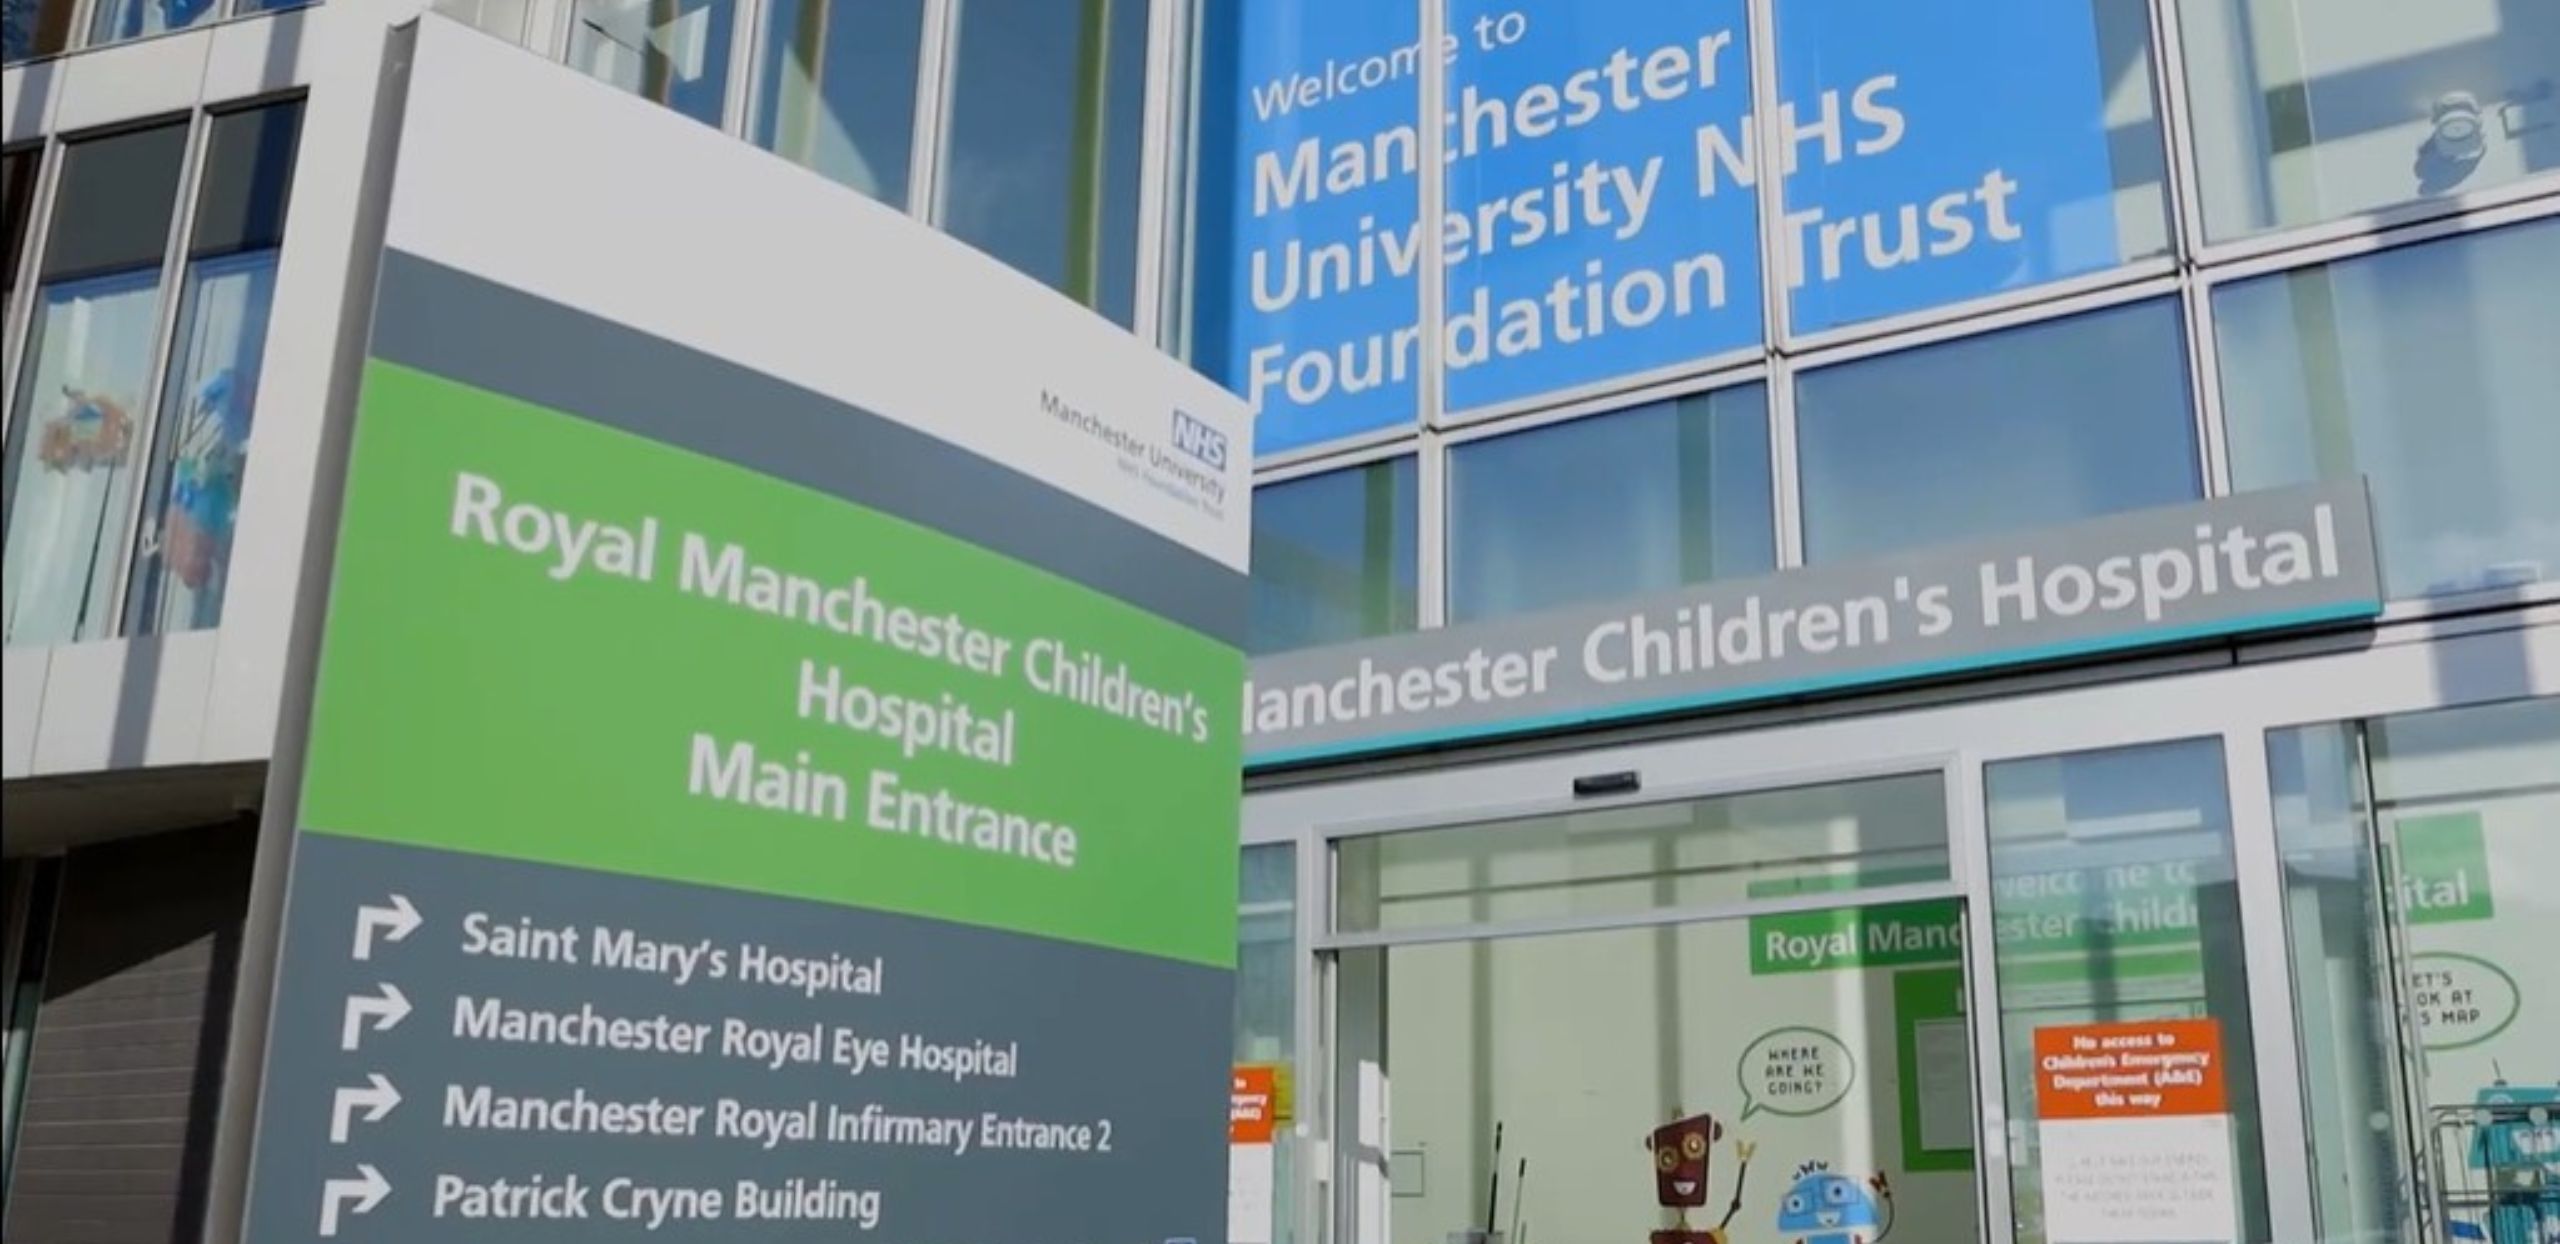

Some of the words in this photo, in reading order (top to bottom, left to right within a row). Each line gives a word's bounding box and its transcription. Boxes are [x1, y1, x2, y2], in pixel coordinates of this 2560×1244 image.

[1253, 34, 1459, 122] Welcome
[1473, 11, 1528, 52] to
[1251, 156, 1664, 313] University
[1697, 75, 1905, 197] NHS
[1250, 253, 1726, 414] Foundation
[1782, 169, 2023, 288] Trust
[1040, 388, 1146, 459] Manchester
[1150, 443, 1225, 504] University
[1174, 412, 1225, 467] NHS
[451, 472, 657, 581] Royal
[679, 532, 1010, 677] Manchester
[1023, 636, 1209, 744] Children's
[1582, 576, 1952, 688] Children's
[1980, 504, 2339, 628] Hospital
[797, 659, 1015, 767] Hospital
[688, 733, 847, 821] Main
[867, 769, 1078, 867] Entrance
[460, 913, 578, 964] Saint
[591, 926, 727, 986] Mary's
[739, 944, 883, 996] Hospital
[1766, 922, 1857, 966] Royal
[452, 996, 710, 1055] Manchester
[722, 1016, 822, 1069] Royal
[832, 1027, 890, 1071] Eye
[899, 1034, 1017, 1080] Hospital
[1768, 1046, 1819, 1060] WHERE
[2441, 1008, 2481, 1025] MAP
[1765, 1064, 1793, 1078] ARE
[442, 1085, 705, 1138] Manchester
[715, 1100, 817, 1151] Royal
[827, 1106, 973, 1154] Infirmary
[980, 1112, 1091, 1151] Entrance
[1097, 1119, 1112, 1151] 2
[433, 1176, 589, 1220] Patrick
[601, 1177, 724, 1229] Cryne
[735, 1179, 881, 1227] Building
